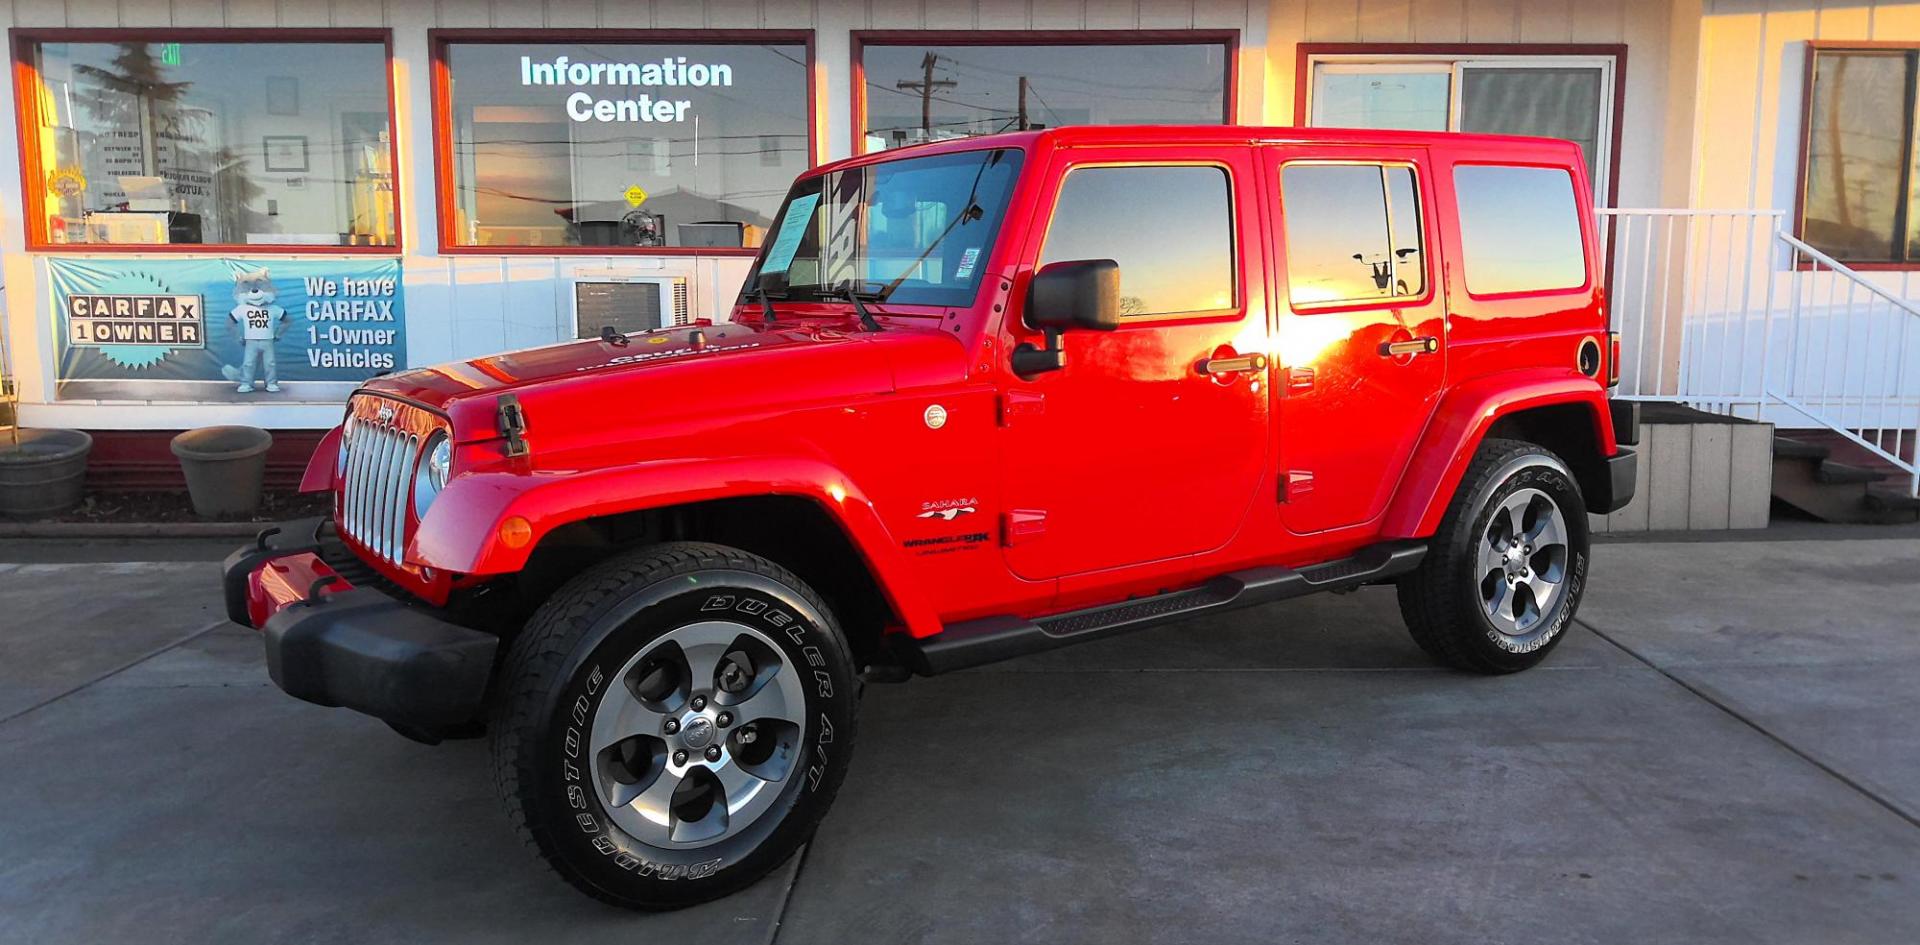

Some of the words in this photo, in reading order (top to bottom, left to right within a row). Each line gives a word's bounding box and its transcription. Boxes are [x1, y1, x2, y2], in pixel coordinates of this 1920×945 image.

[520, 56, 732, 86] Information
[566, 91, 691, 122] Center
[305, 277, 338, 297] We
[347, 277, 394, 297] have
[71, 297, 195, 318] CARFAX
[246, 309, 269, 320] CAR
[307, 301, 394, 321] CARFAX
[76, 323, 88, 341] 1
[95, 323, 198, 341] OWNER
[249, 319, 270, 330] FOX
[308, 325, 395, 345] 1-Owner
[307, 348, 394, 369] Vehicles
[922, 497, 978, 510] SAHARA
[701, 595, 833, 699] DUELER
[811, 713, 833, 792] A/T
[564, 665, 722, 881] BRIDGESTONE
